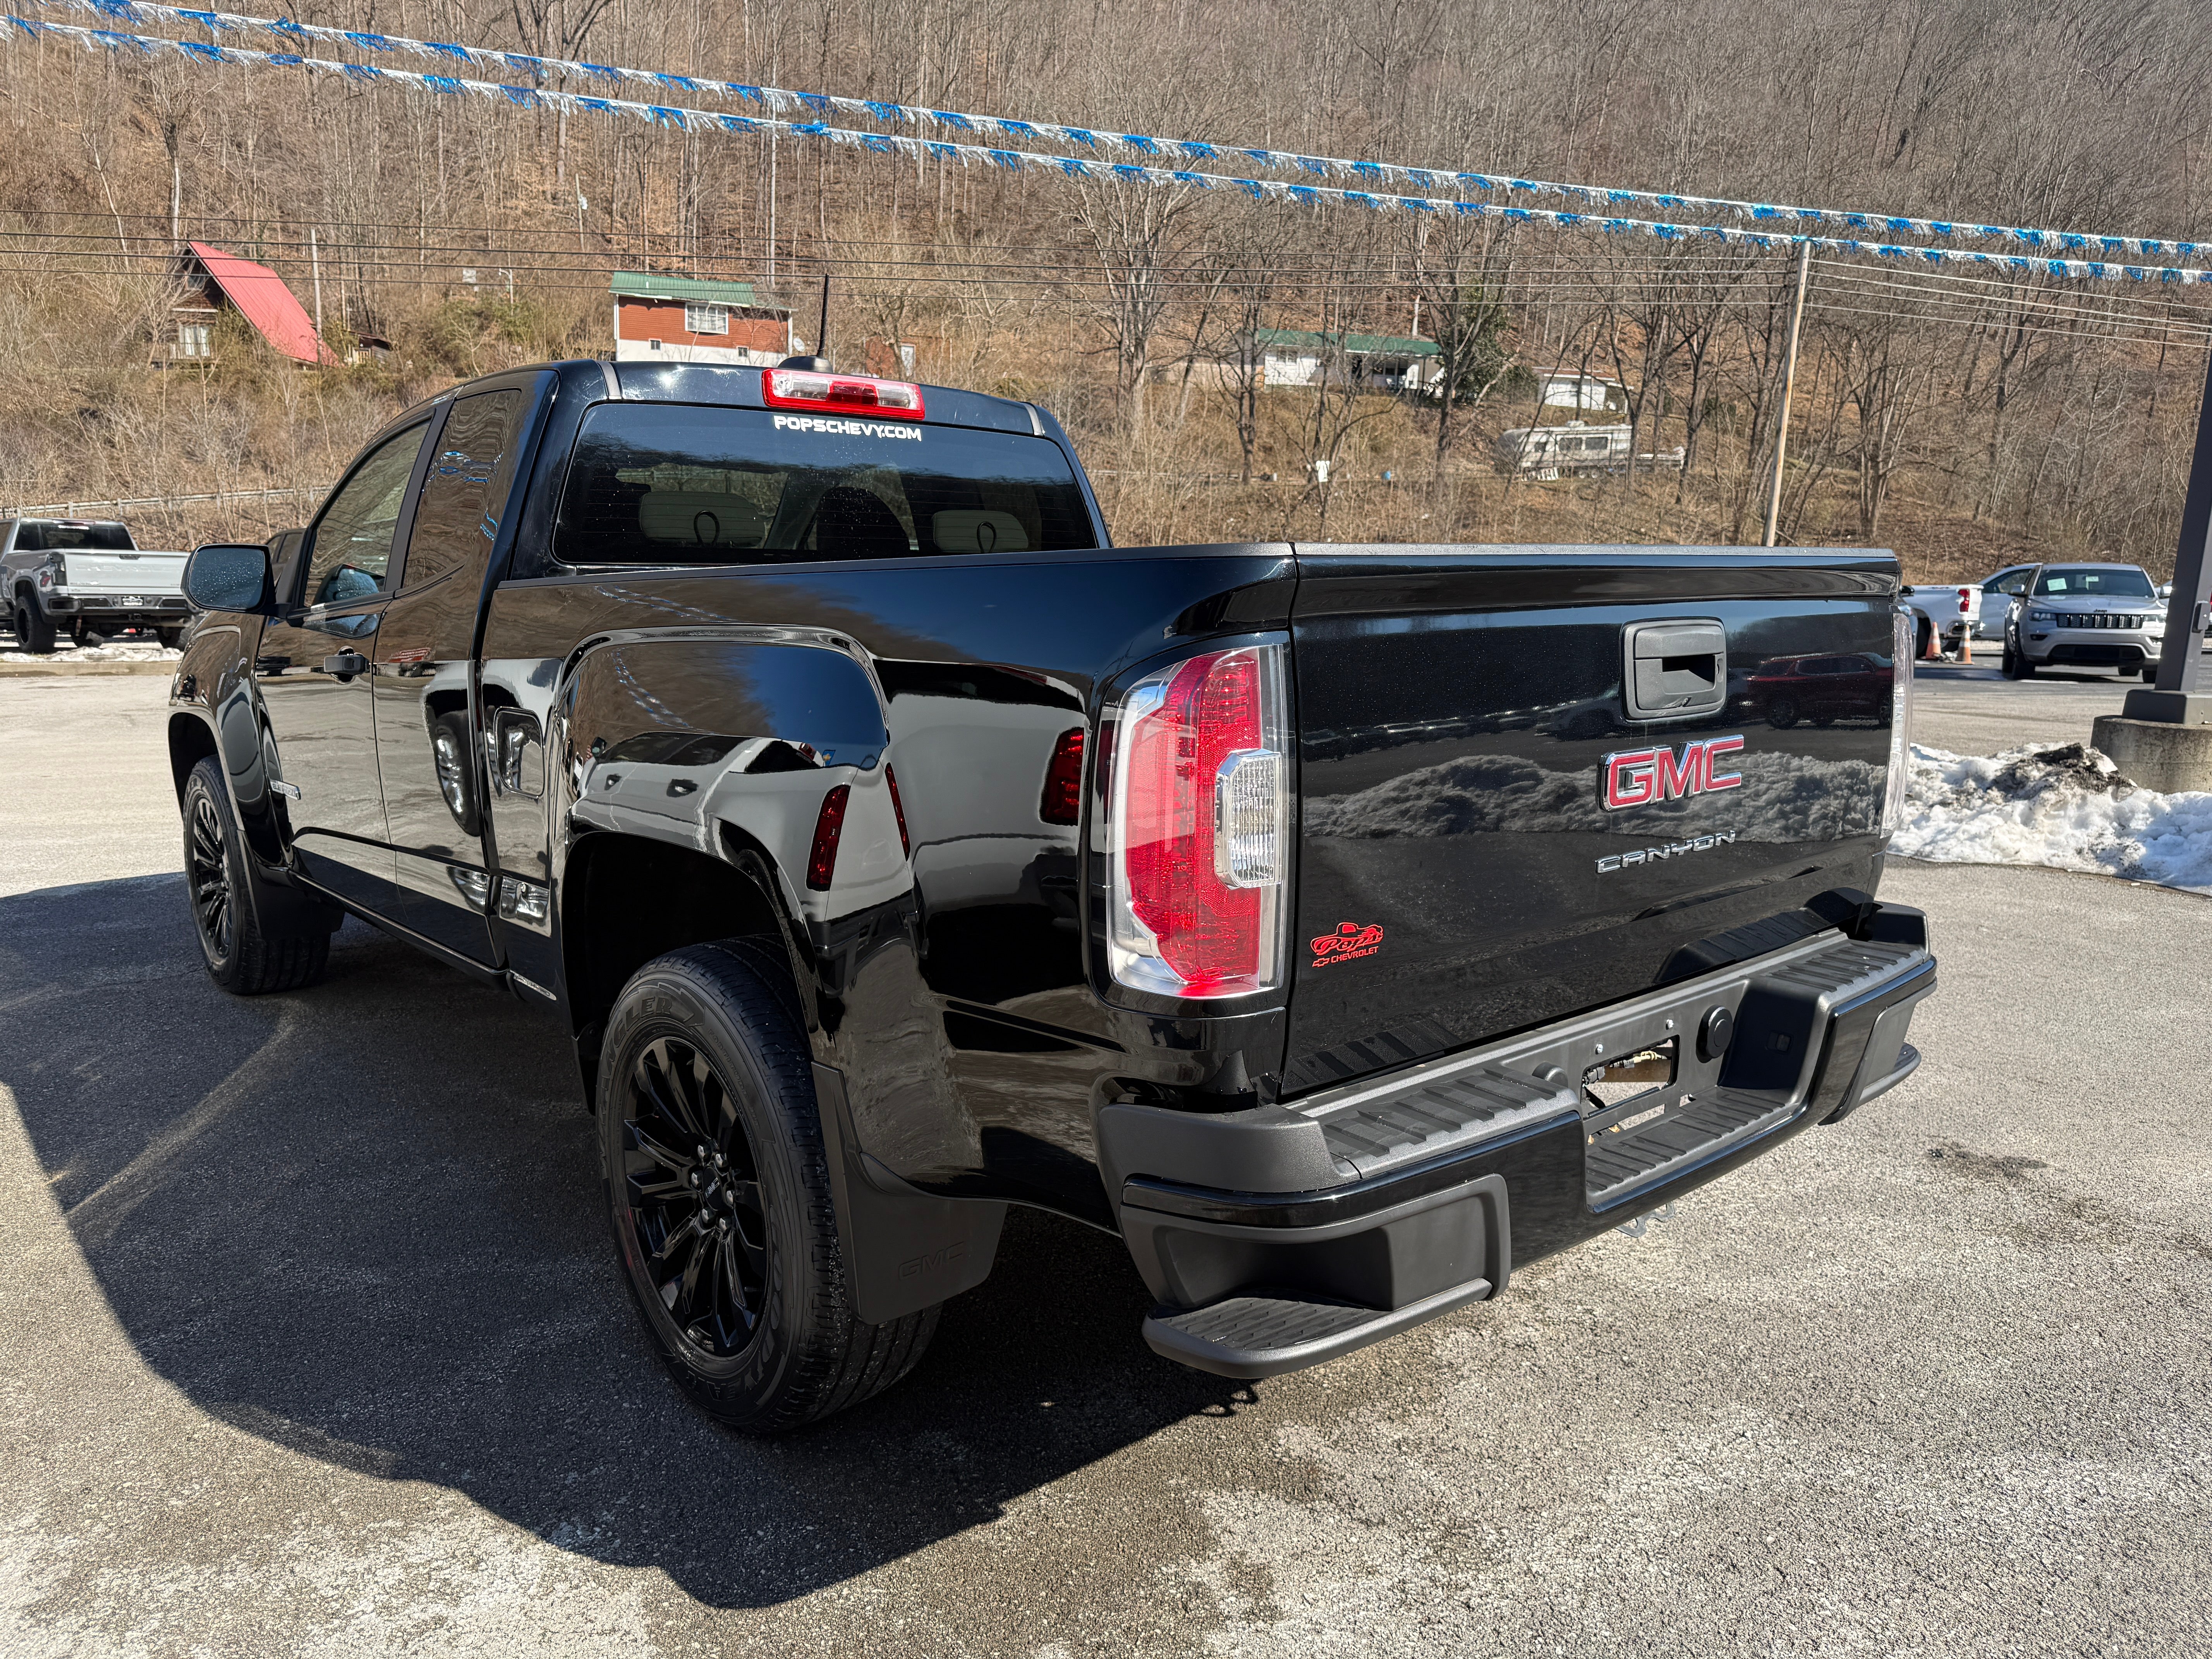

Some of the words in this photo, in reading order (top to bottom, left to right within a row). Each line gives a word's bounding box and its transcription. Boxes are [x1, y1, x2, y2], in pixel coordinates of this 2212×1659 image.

[773, 416, 922, 442] POPSCHEVY.COM
[1596, 734, 1744, 812] GMC
[1595, 830, 1735, 873] CANYON
[1331, 946, 1379, 963] CHEVROLET
[898, 1241, 964, 1280] GMC
